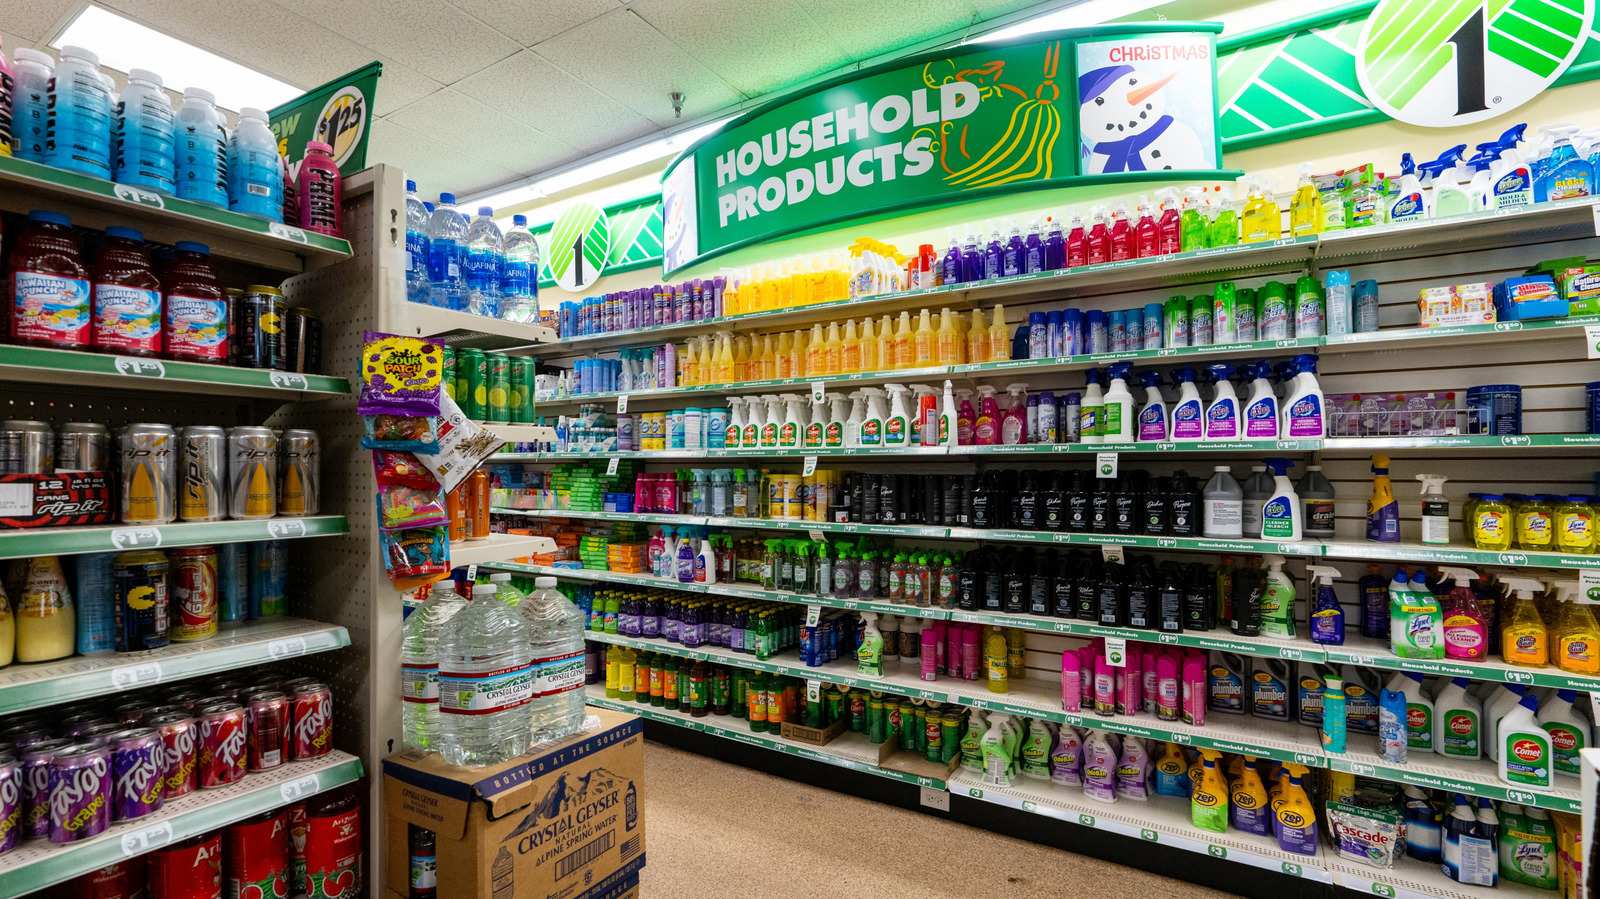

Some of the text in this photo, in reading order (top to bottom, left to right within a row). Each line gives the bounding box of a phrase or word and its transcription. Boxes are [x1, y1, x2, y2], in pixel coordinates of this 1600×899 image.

[1446, 6, 1491, 117] 1
[716, 81, 981, 188] HOUSEHOLD
[718, 137, 935, 228] PRODUCTS
[1555, 178, 1585, 187] GLASS
[309, 168, 337, 230] PRIME
[572, 233, 584, 288] 1
[16, 278, 66, 289] HAWAIIAN
[1518, 284, 1549, 292] Glass
[21, 287, 58, 297] PUNCH
[96, 289, 139, 300] HAWAIIAN
[1518, 287, 1550, 296] Cleaner
[100, 298, 133, 306] PUNCH
[168, 300, 207, 310] HAWAIIAN
[172, 308, 201, 316] PUNCH
[1555, 317, 1599, 325] Household
[386, 357, 420, 365] SOUR
[384, 364, 421, 373] PATCH
[39, 481, 63, 489] 12
[37, 502, 79, 516] rip
[80, 500, 104, 511] it
[1481, 519, 1499, 529] Lysol
[1528, 518, 1546, 528] Lysol
[1567, 519, 1587, 530] Lysol
[399, 538, 434, 547] DINOSAUR
[1260, 602, 1279, 610] doBan
[1411, 614, 1431, 629] Lysol
[1199, 640, 1229, 648] Household
[1402, 663, 1474, 674] Household Products
[548, 671, 569, 682] CRYSTAL
[486, 682, 531, 700] CRYSTAL GEYSER
[1212, 684, 1242, 697] plumber
[1254, 689, 1286, 701] plumber
[1101, 723, 1151, 736] Household Products
[1450, 721, 1473, 731] Comet
[553, 754, 564, 766] AT
[572, 743, 590, 757] THE
[597, 725, 632, 747] SOURCE
[1213, 741, 1271, 756] Household Products
[1514, 746, 1542, 758] Comet
[1053, 755, 1076, 763] OdoBan
[1086, 769, 1107, 778] OdoBan
[1117, 767, 1140, 776] OdoBan
[1403, 774, 1476, 791] Household Products
[50, 756, 107, 827] Faygo
[402, 788, 438, 807] CRYSTAL GEYSER
[63, 792, 105, 831] Grape!
[517, 790, 619, 855] CRYSTAL GEYSER
[1081, 816, 1092, 824] $3
[555, 821, 591, 845] NATURAL
[1143, 831, 1154, 840] $3
[1333, 821, 1389, 845] Cascade
[536, 815, 617, 867] ALPINE SPRING WATER
[1211, 845, 1222, 855] $3
[1517, 842, 1544, 857] Lysol
[1284, 863, 1297, 874] $3
[1374, 884, 1389, 896] $5
